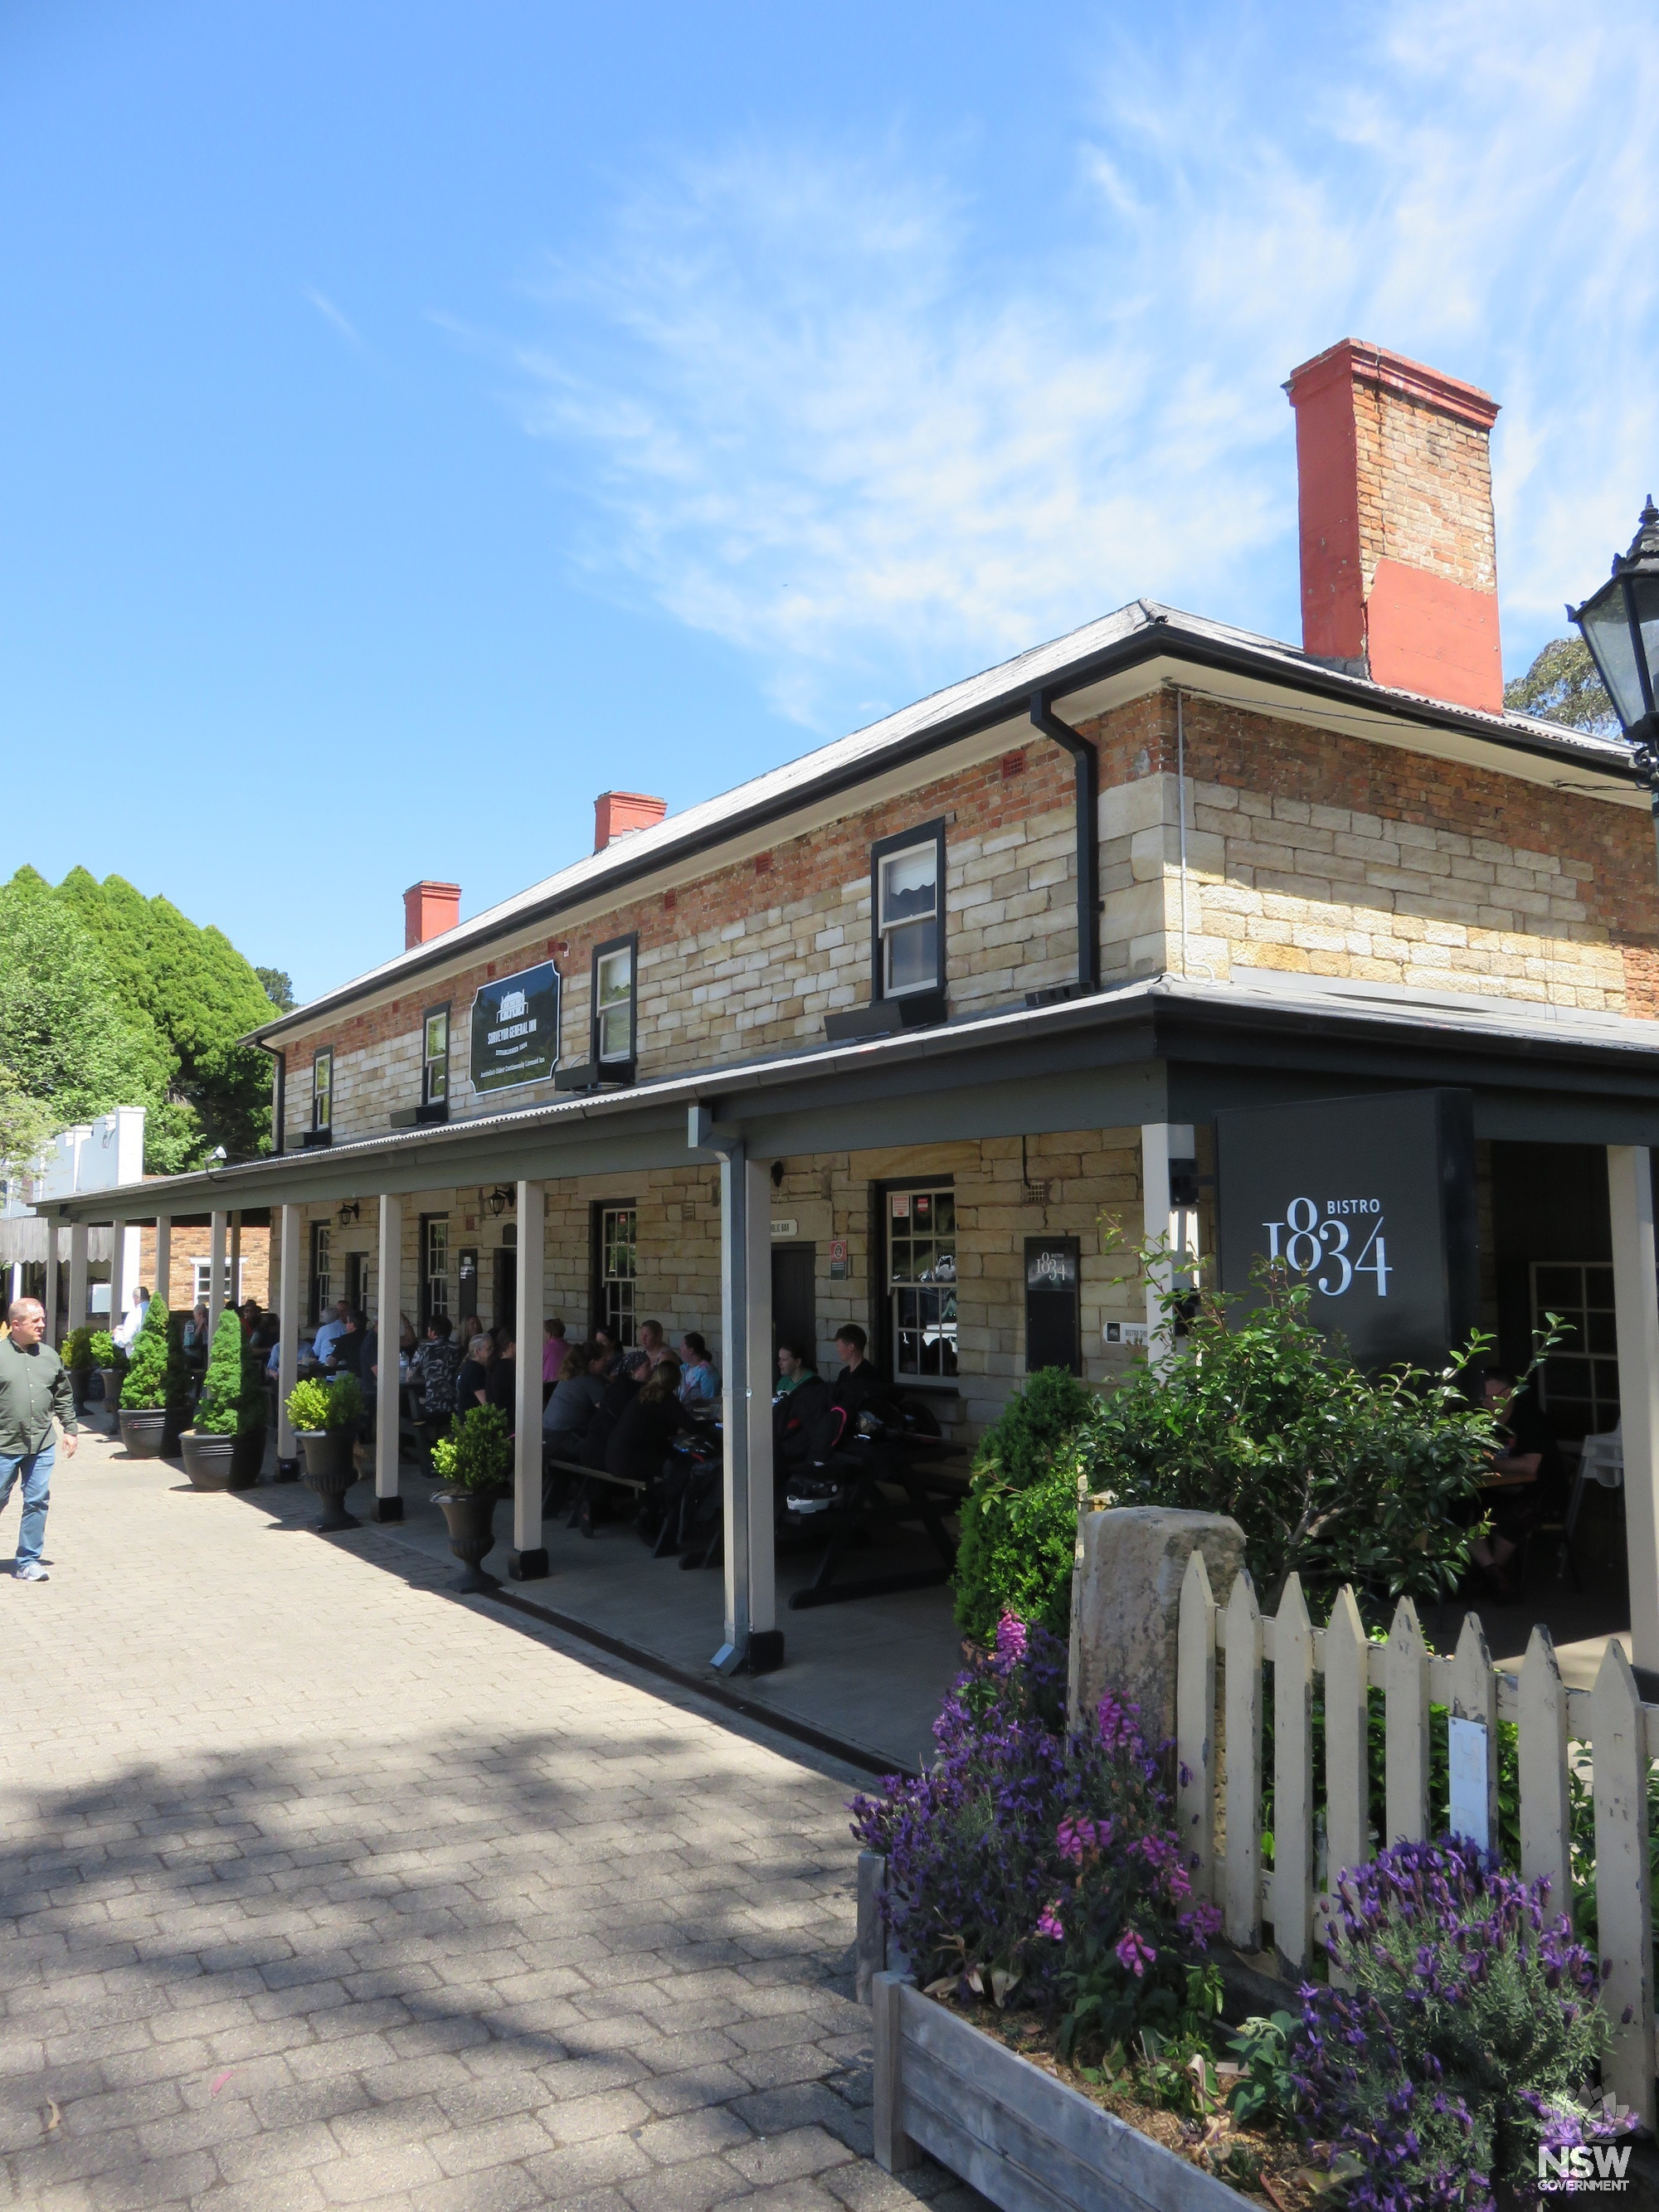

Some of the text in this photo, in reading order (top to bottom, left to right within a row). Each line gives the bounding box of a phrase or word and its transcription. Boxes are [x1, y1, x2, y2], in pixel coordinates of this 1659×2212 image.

[509, 1022, 528, 1038] GENERAL
[496, 1046, 519, 1056] ESTABLISHED
[1327, 1198, 1380, 1214] BISTRO
[781, 1223, 790, 1232] BAR
[1262, 1197, 1394, 1296] 1834
[1036, 1252, 1067, 1281] 1834
